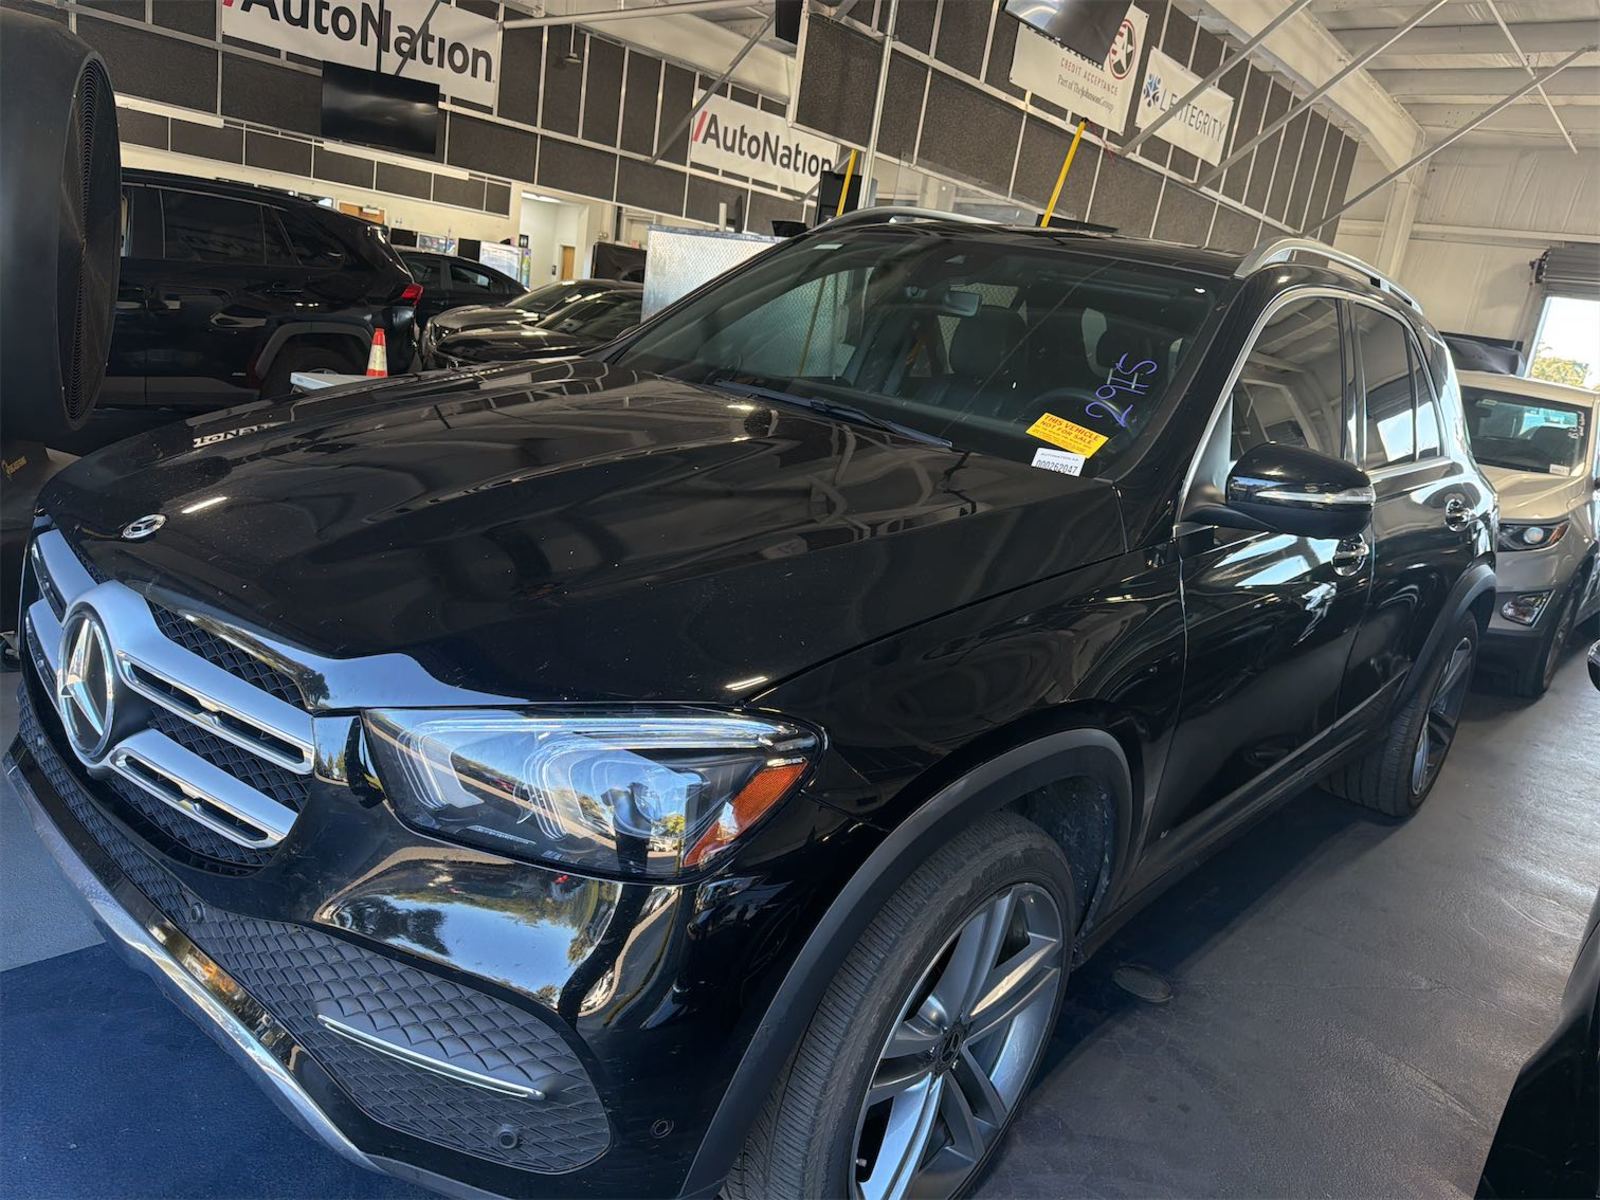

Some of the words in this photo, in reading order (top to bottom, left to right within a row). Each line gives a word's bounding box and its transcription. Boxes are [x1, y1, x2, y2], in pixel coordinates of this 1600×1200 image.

[1040, 420, 1055, 430] NOT
[1056, 427, 1073, 437] FOR
[1074, 434, 1092, 445] SALE
[1044, 414, 1062, 426] THIS
[1064, 421, 1100, 442] VEHICLE
